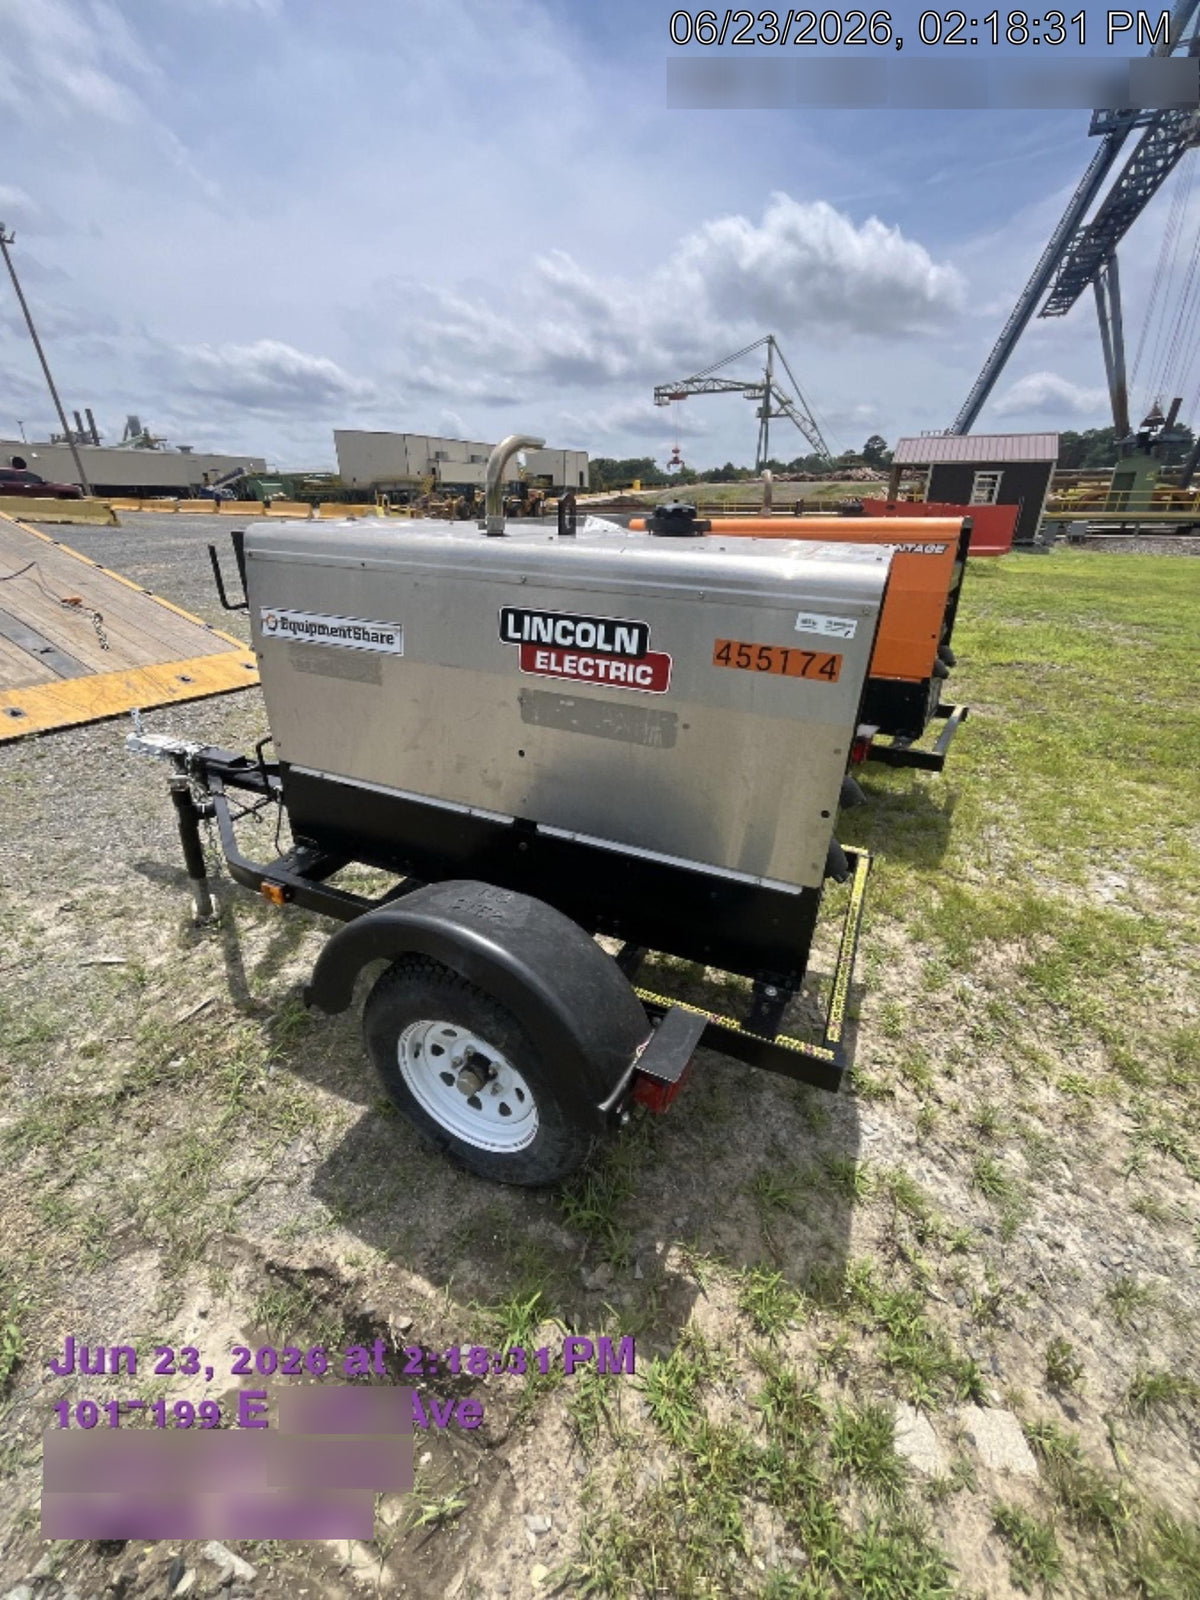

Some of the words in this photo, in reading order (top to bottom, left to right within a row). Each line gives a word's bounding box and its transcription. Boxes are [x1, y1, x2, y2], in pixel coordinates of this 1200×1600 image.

[280, 616, 395, 645] EquipmentShare
[506, 613, 640, 656] LINCOLN
[534, 650, 654, 686] ELECTRIC
[715, 642, 837, 681] 455174
